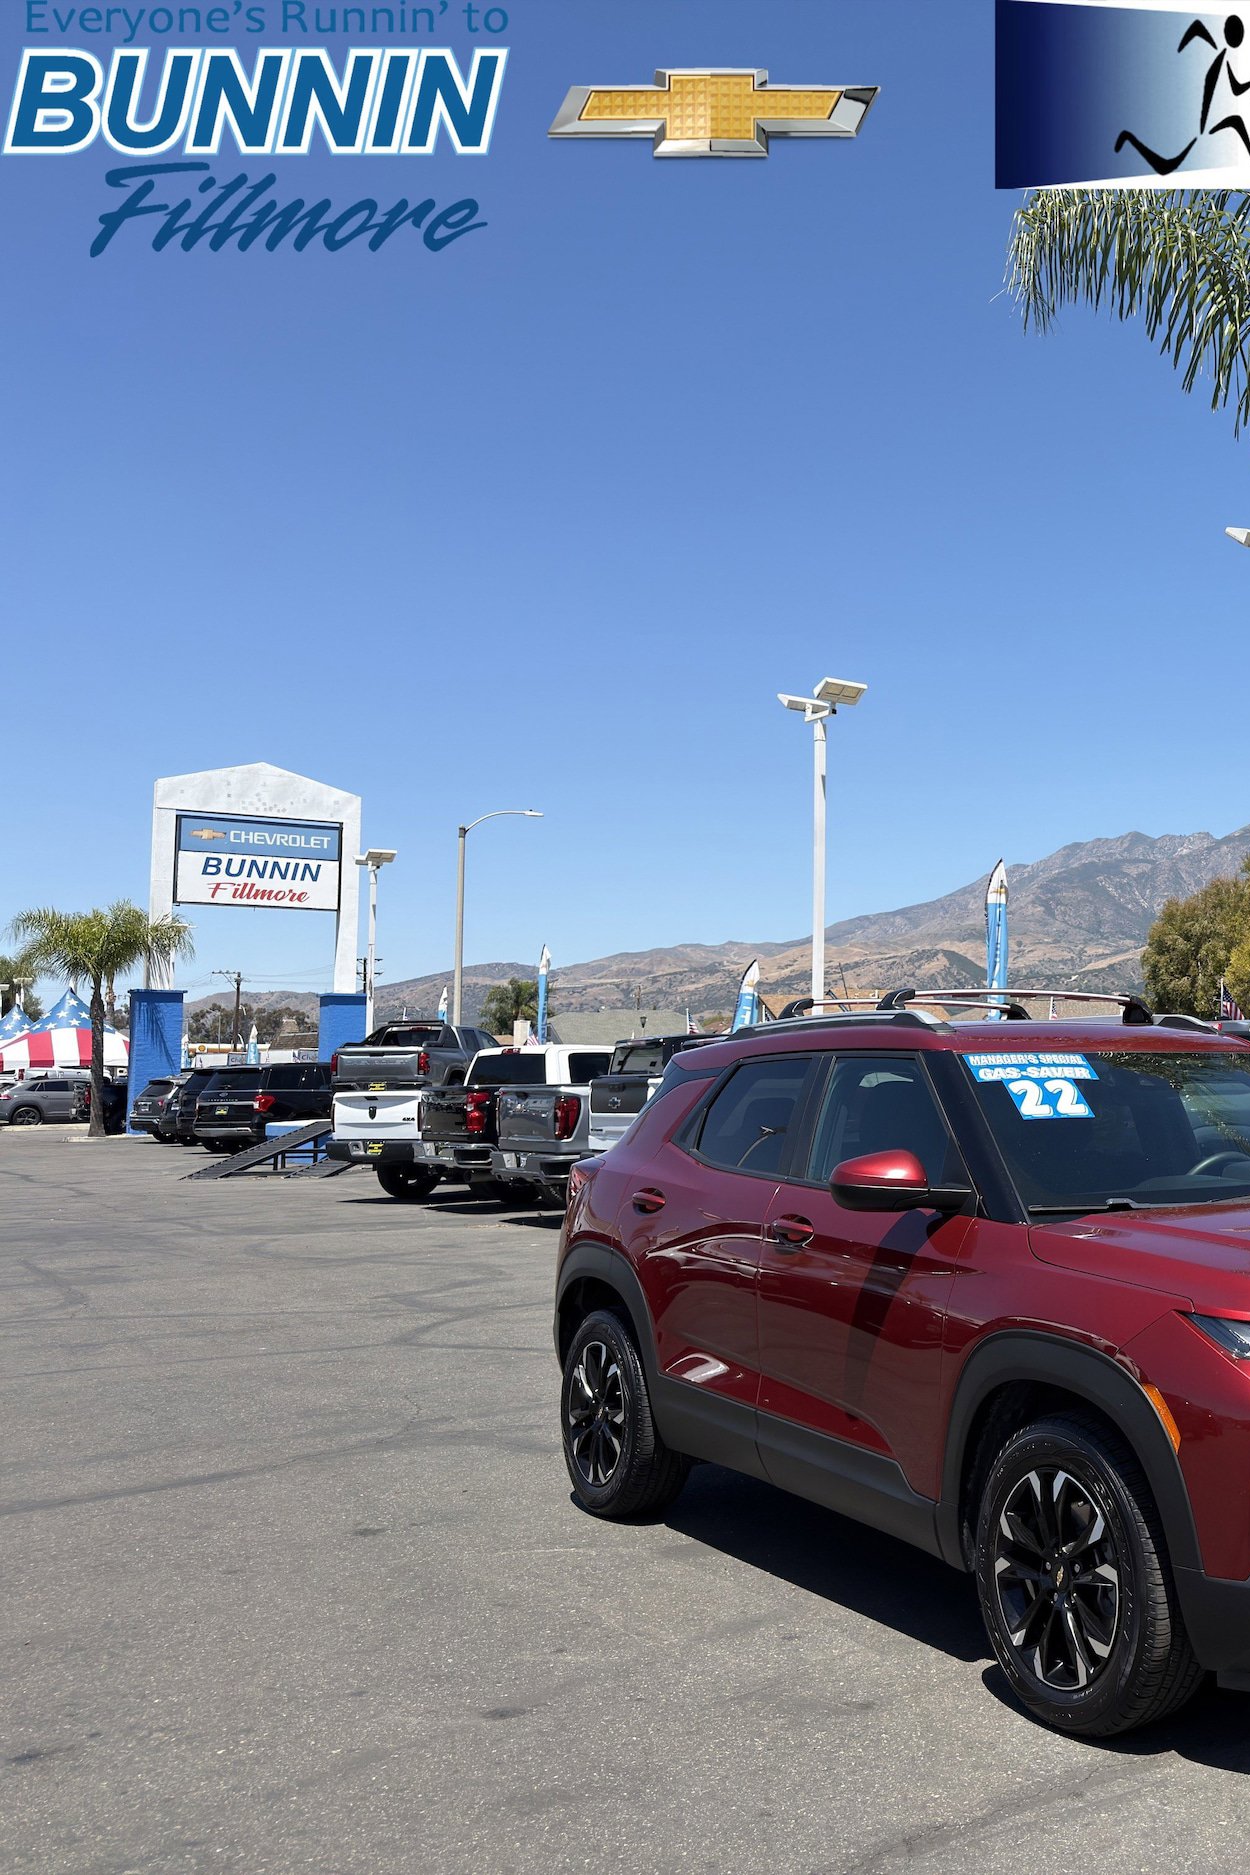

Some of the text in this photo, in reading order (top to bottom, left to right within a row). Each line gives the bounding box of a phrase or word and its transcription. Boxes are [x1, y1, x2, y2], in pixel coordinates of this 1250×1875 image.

[229, 830, 331, 849] CHEVROLET
[201, 856, 322, 882] BUNNIN
[206, 882, 310, 903] Fillmore
[968, 1054, 1087, 1066] MANAGER'S SPECIAL
[978, 1066, 1092, 1080] GAS-SAVER
[1008, 1079, 1089, 1116] 22
